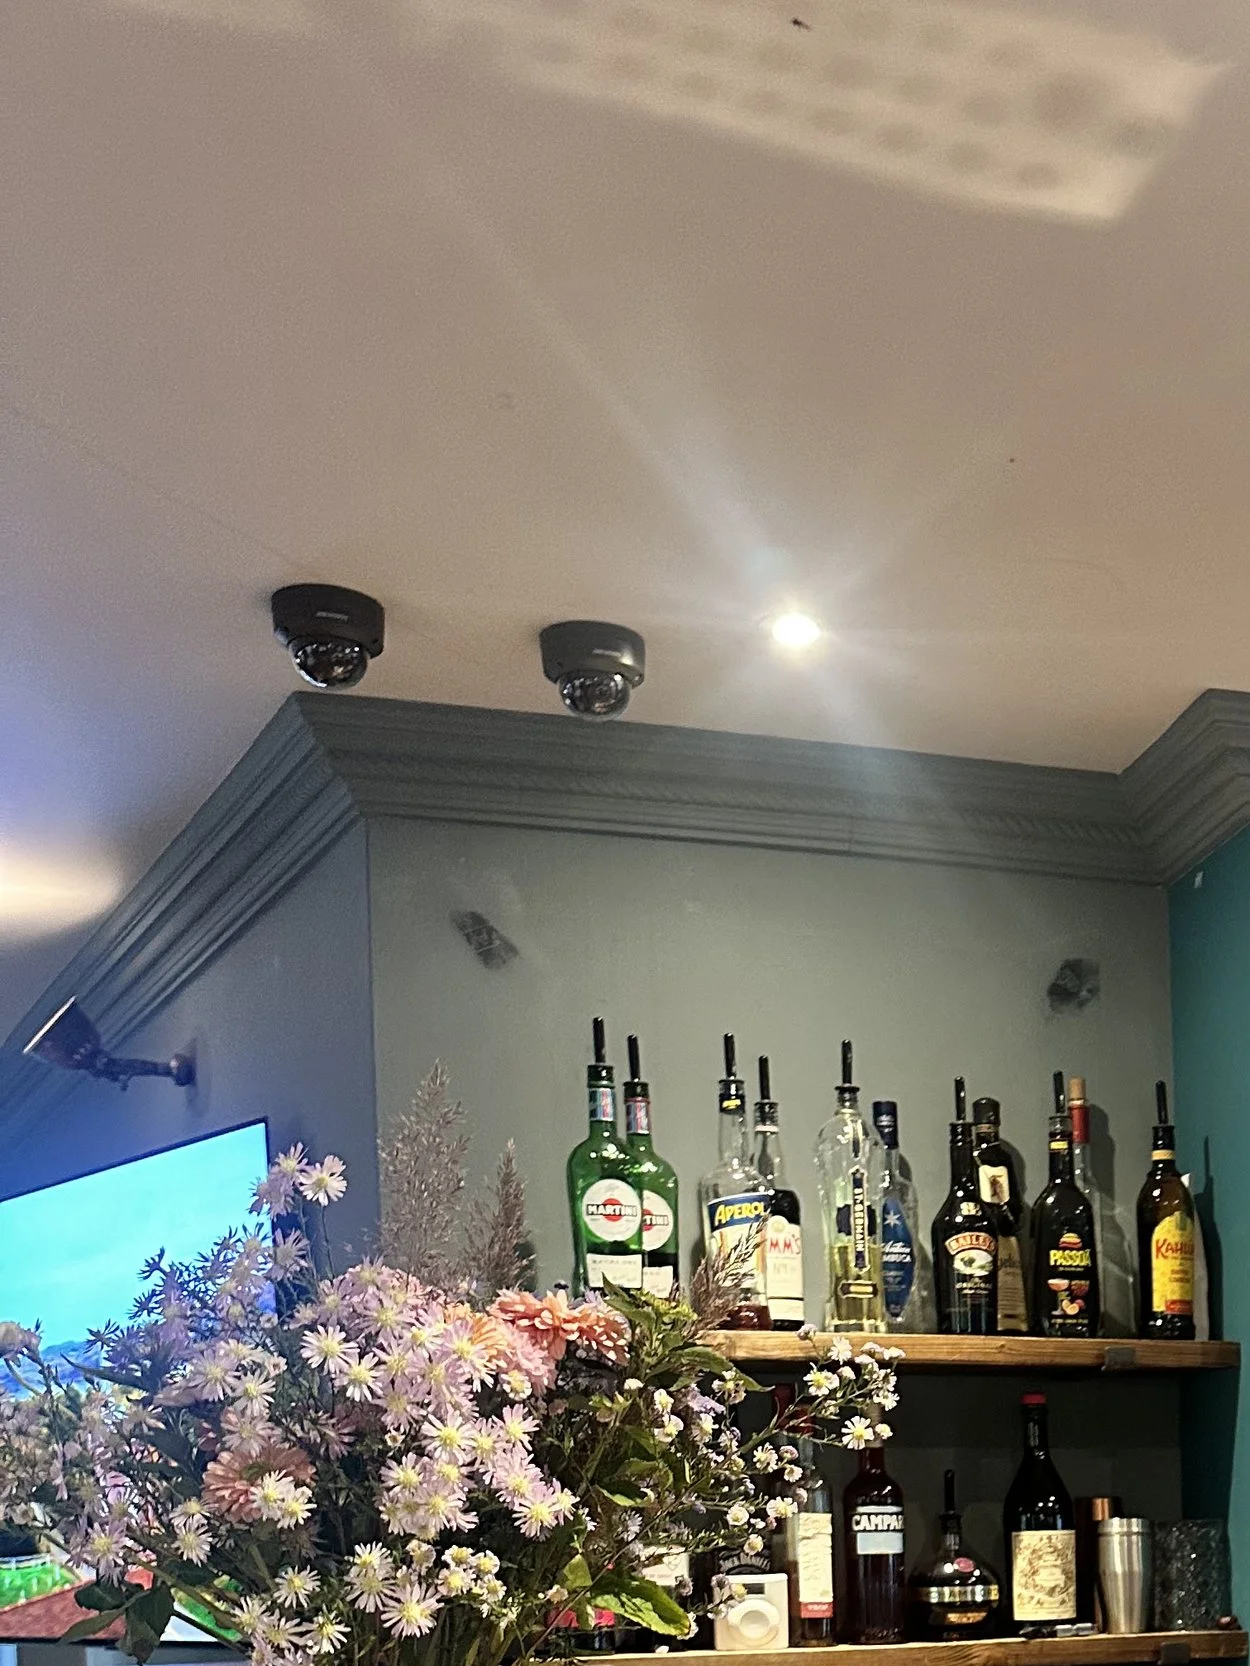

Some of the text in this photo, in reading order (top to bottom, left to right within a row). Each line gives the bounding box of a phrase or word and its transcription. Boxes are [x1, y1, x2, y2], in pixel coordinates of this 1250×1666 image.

[587, 1203, 638, 1217] MARTINI
[714, 1200, 767, 1227] APEROL
[643, 1214, 669, 1226] TINI
[768, 1234, 801, 1255] MM'S
